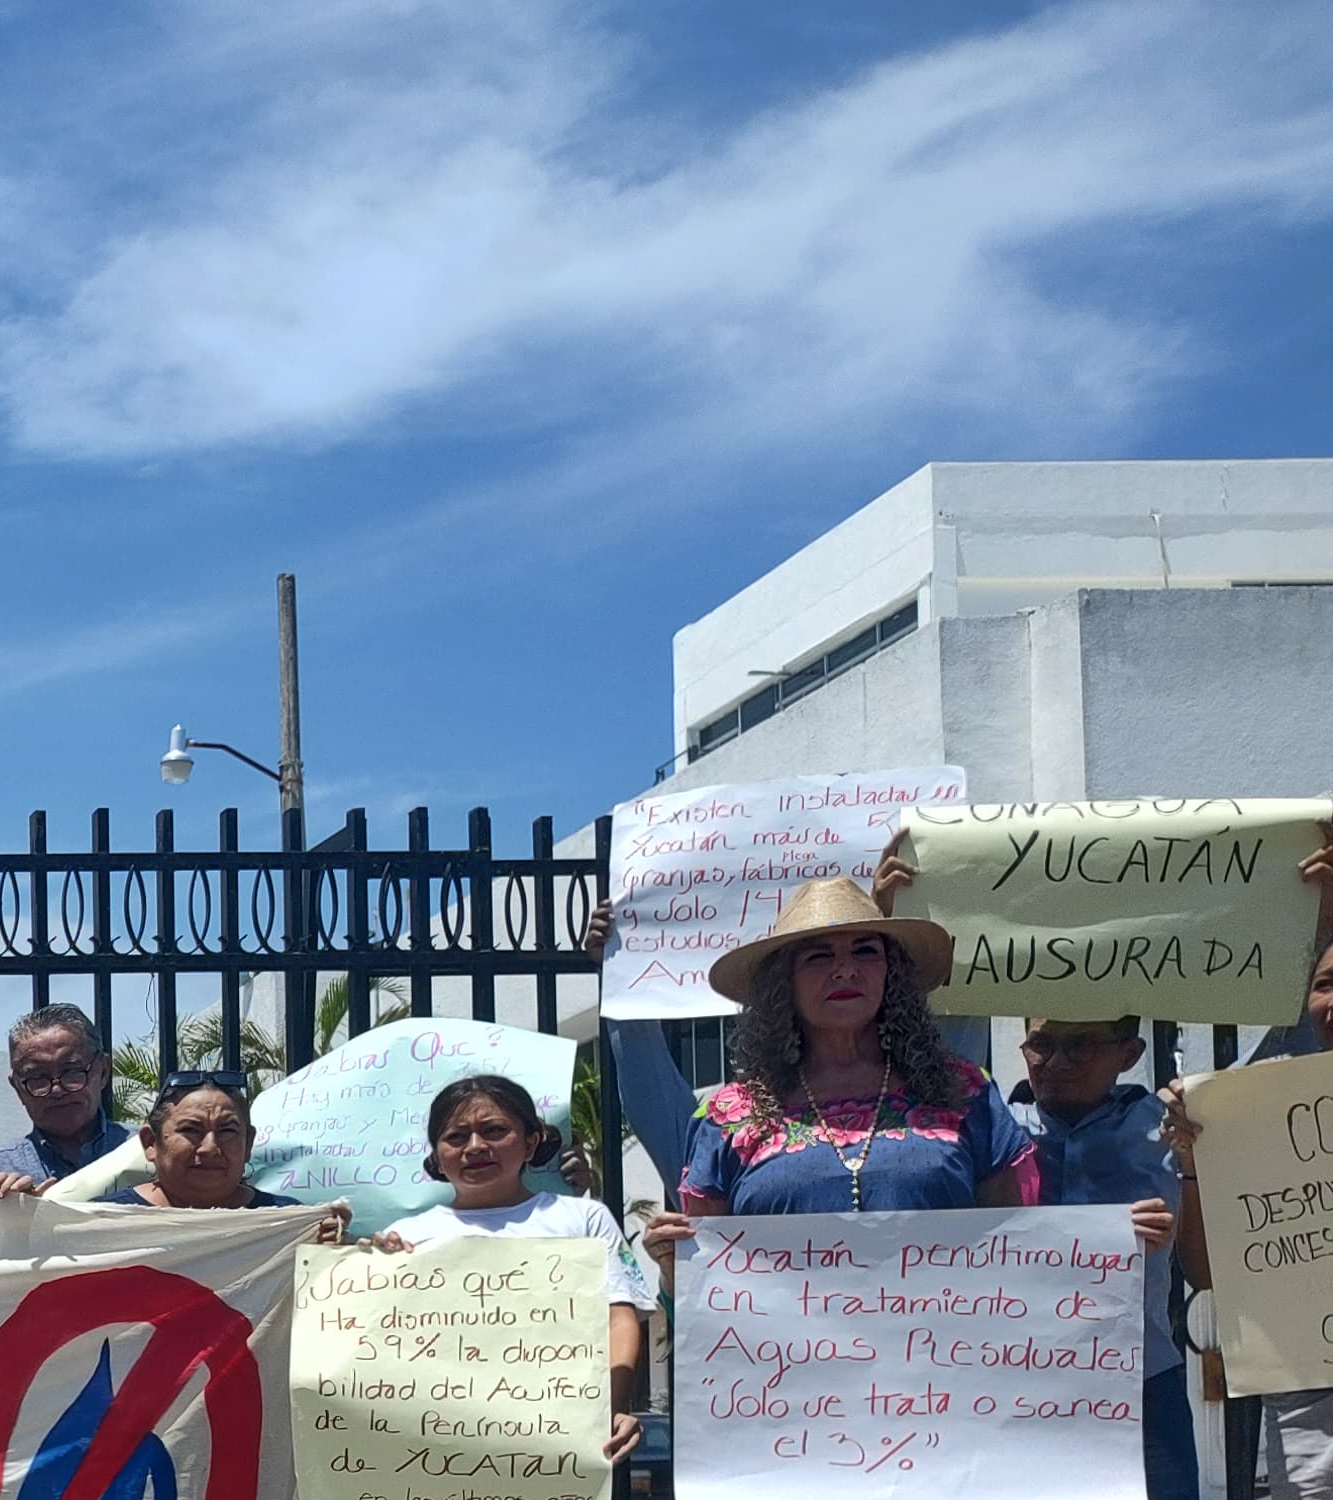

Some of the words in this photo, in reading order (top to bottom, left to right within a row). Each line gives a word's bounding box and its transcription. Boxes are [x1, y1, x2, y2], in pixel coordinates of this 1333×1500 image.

[991, 826, 1263, 891] YUCATÁN
[706, 1230, 869, 1274] Yucatán
[707, 1285, 767, 1316] en
[797, 1280, 1028, 1321] tratamiento
[1055, 1289, 1102, 1321] de
[320, 1308, 365, 1331] Ha
[458, 1335, 488, 1362] la
[704, 1326, 877, 1388] Aguas
[906, 1327, 1140, 1373] Residuales
[318, 1367, 416, 1402] bilidad
[430, 1376, 474, 1401] del
[869, 1382, 951, 1418] trata
[973, 1396, 997, 1417] o
[1012, 1398, 1140, 1423] sanea
[315, 1409, 349, 1431] de
[369, 1411, 401, 1434] la
[421, 1410, 570, 1438] Península
[330, 1447, 377, 1473] de
[774, 1430, 807, 1459] el
